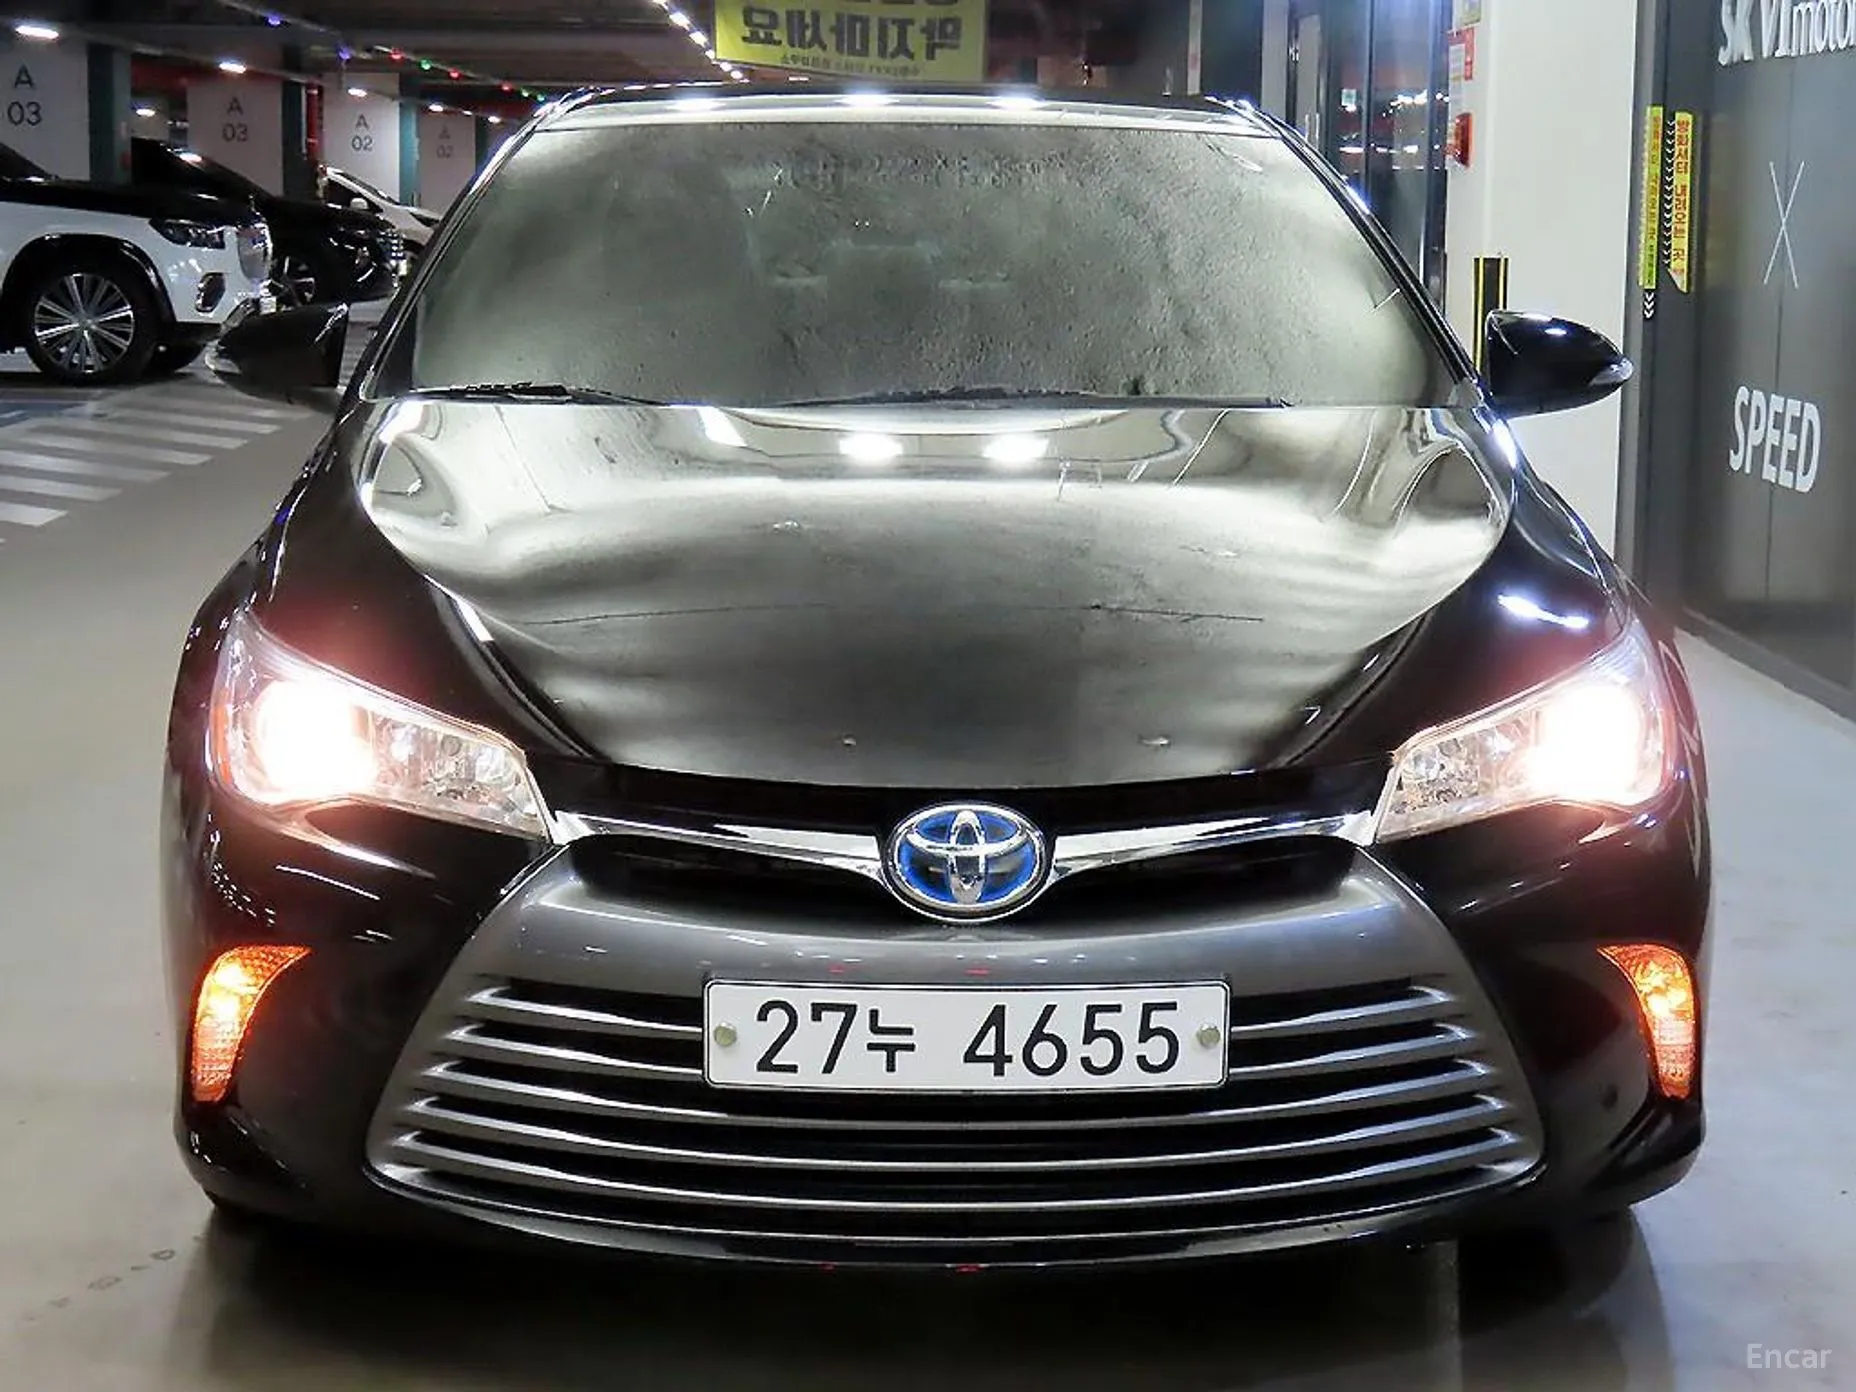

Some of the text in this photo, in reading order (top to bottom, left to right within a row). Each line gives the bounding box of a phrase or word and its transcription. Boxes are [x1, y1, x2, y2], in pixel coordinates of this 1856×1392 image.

[1718, 0, 1754, 66] SK
[13, 64, 34, 89] A
[7, 101, 42, 126] 03
[227, 97, 244, 115] A
[222, 122, 249, 142] 03
[354, 113, 370, 130] A
[351, 135, 374, 151] 02
[1728, 385, 1821, 493] SPEED
[755, 999, 1180, 1077] 27누 4655
